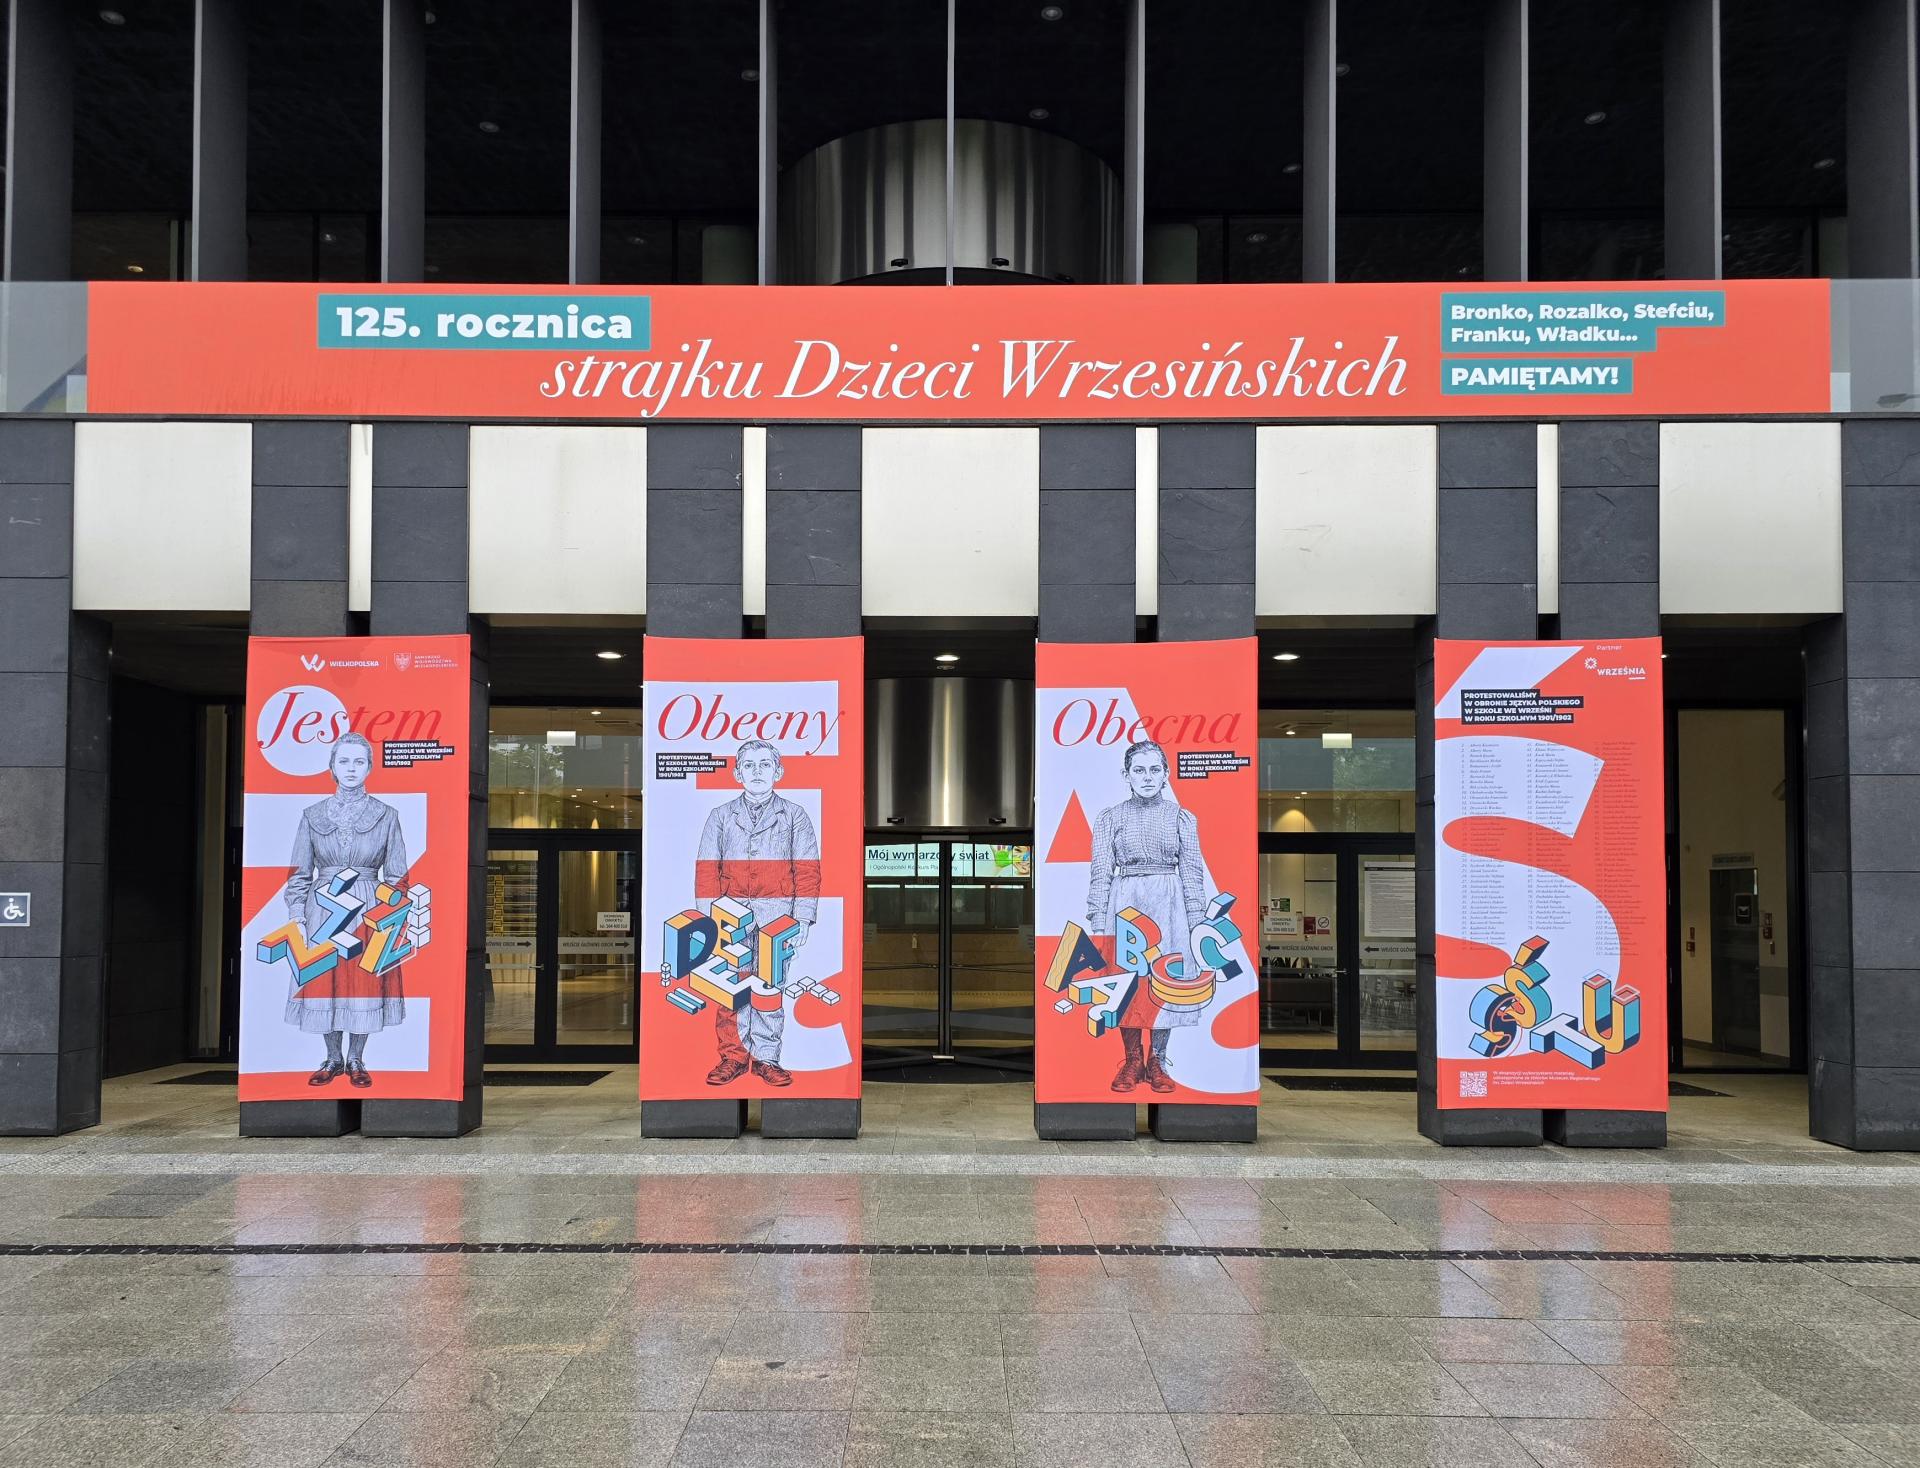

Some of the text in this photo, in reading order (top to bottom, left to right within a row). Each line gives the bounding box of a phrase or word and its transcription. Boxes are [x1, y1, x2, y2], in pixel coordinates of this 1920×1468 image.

[336, 304, 632, 339] 125. rocznica
[1451, 302, 1714, 322] Bronko, Rozalko, Stefciu,
[1451, 326, 1638, 344] Franku, Władku...
[540, 336, 1408, 418] strajku Dzieci Wrzesińskich
[1451, 367, 1618, 390] PAMIĘTAMY!
[1597, 665, 1646, 676] WRZEŚNIA
[258, 691, 442, 749] Jestem
[658, 692, 845, 756] Obecny
[1052, 698, 1242, 747] Obecna
[868, 849, 989, 862] Mój wymarzoy świat
